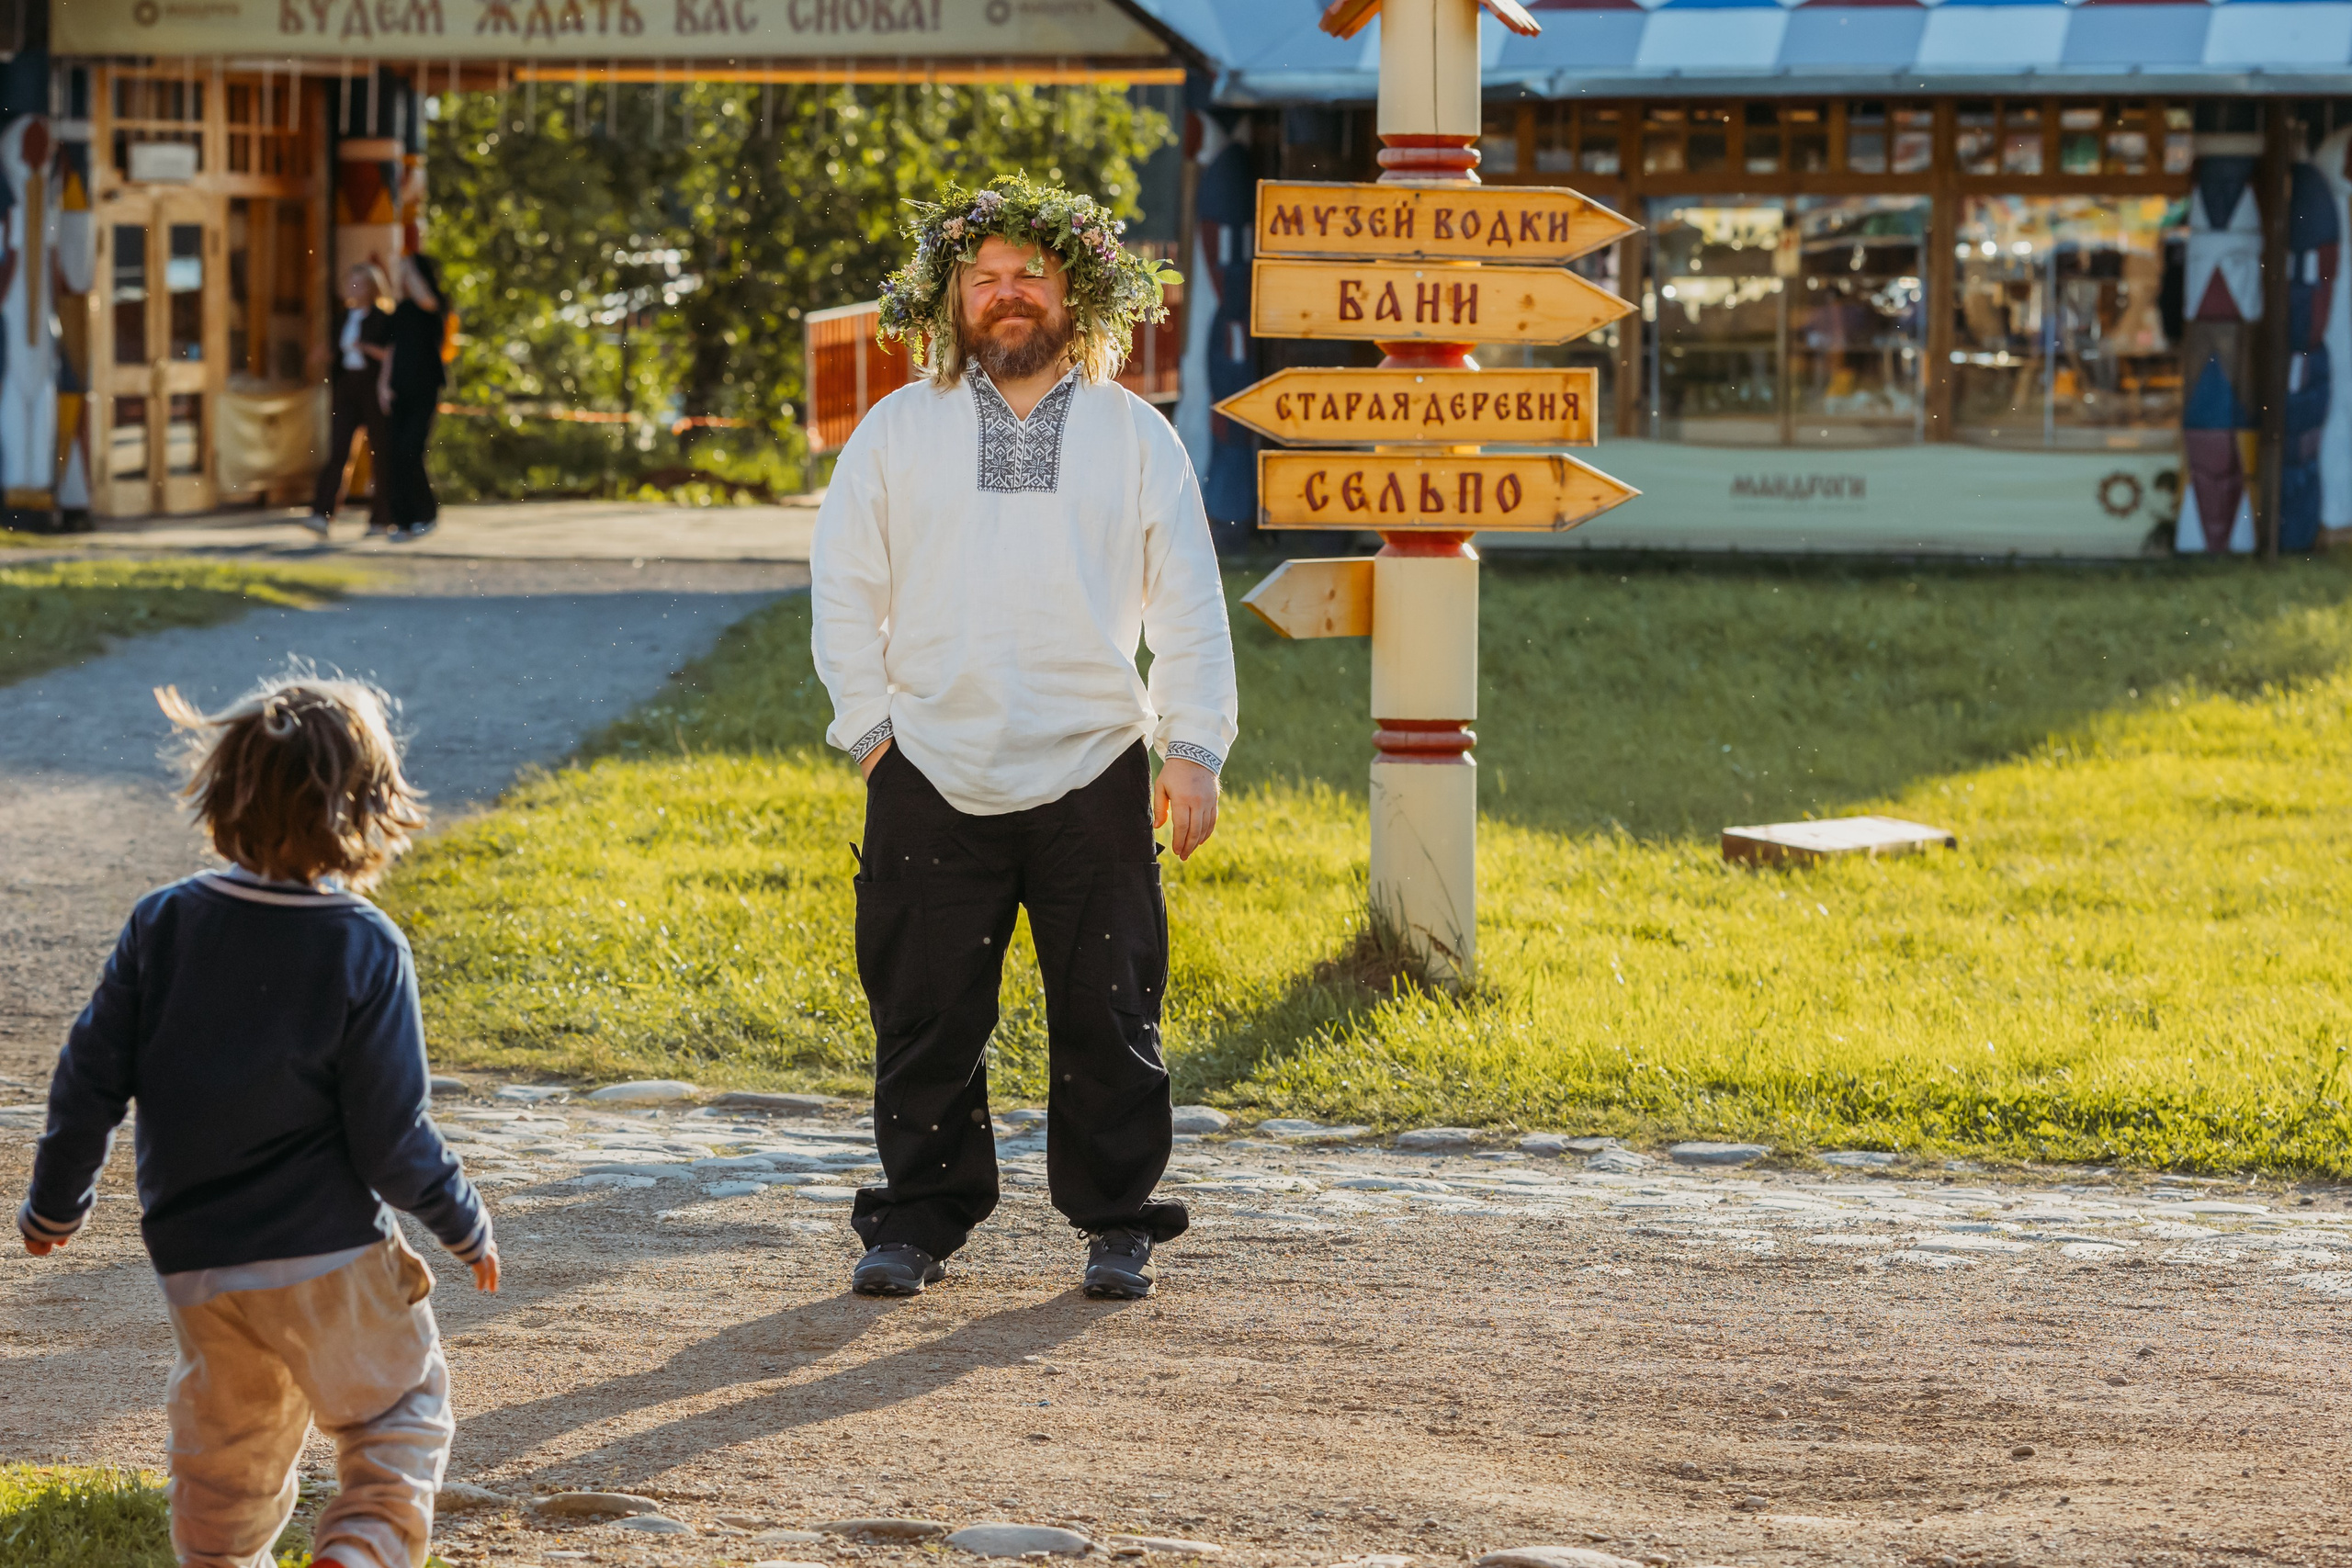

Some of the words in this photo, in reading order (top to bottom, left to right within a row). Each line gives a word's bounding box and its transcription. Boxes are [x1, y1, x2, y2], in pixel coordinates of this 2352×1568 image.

[277, 0, 446, 43] БУДЕМ
[473, 0, 645, 44] ЖДАТЬ
[673, 0, 759, 36] ВАС
[1269, 201, 1414, 238] МУЗЕЙ
[1433, 208, 1569, 248] ВОДКИ
[1339, 279, 1478, 324] БАНИ
[1275, 391, 1411, 422] СТАРАЯ
[1422, 392, 1580, 426] ДЕРЕВНЯ
[1305, 470, 1522, 514] СЕЛЬПО
